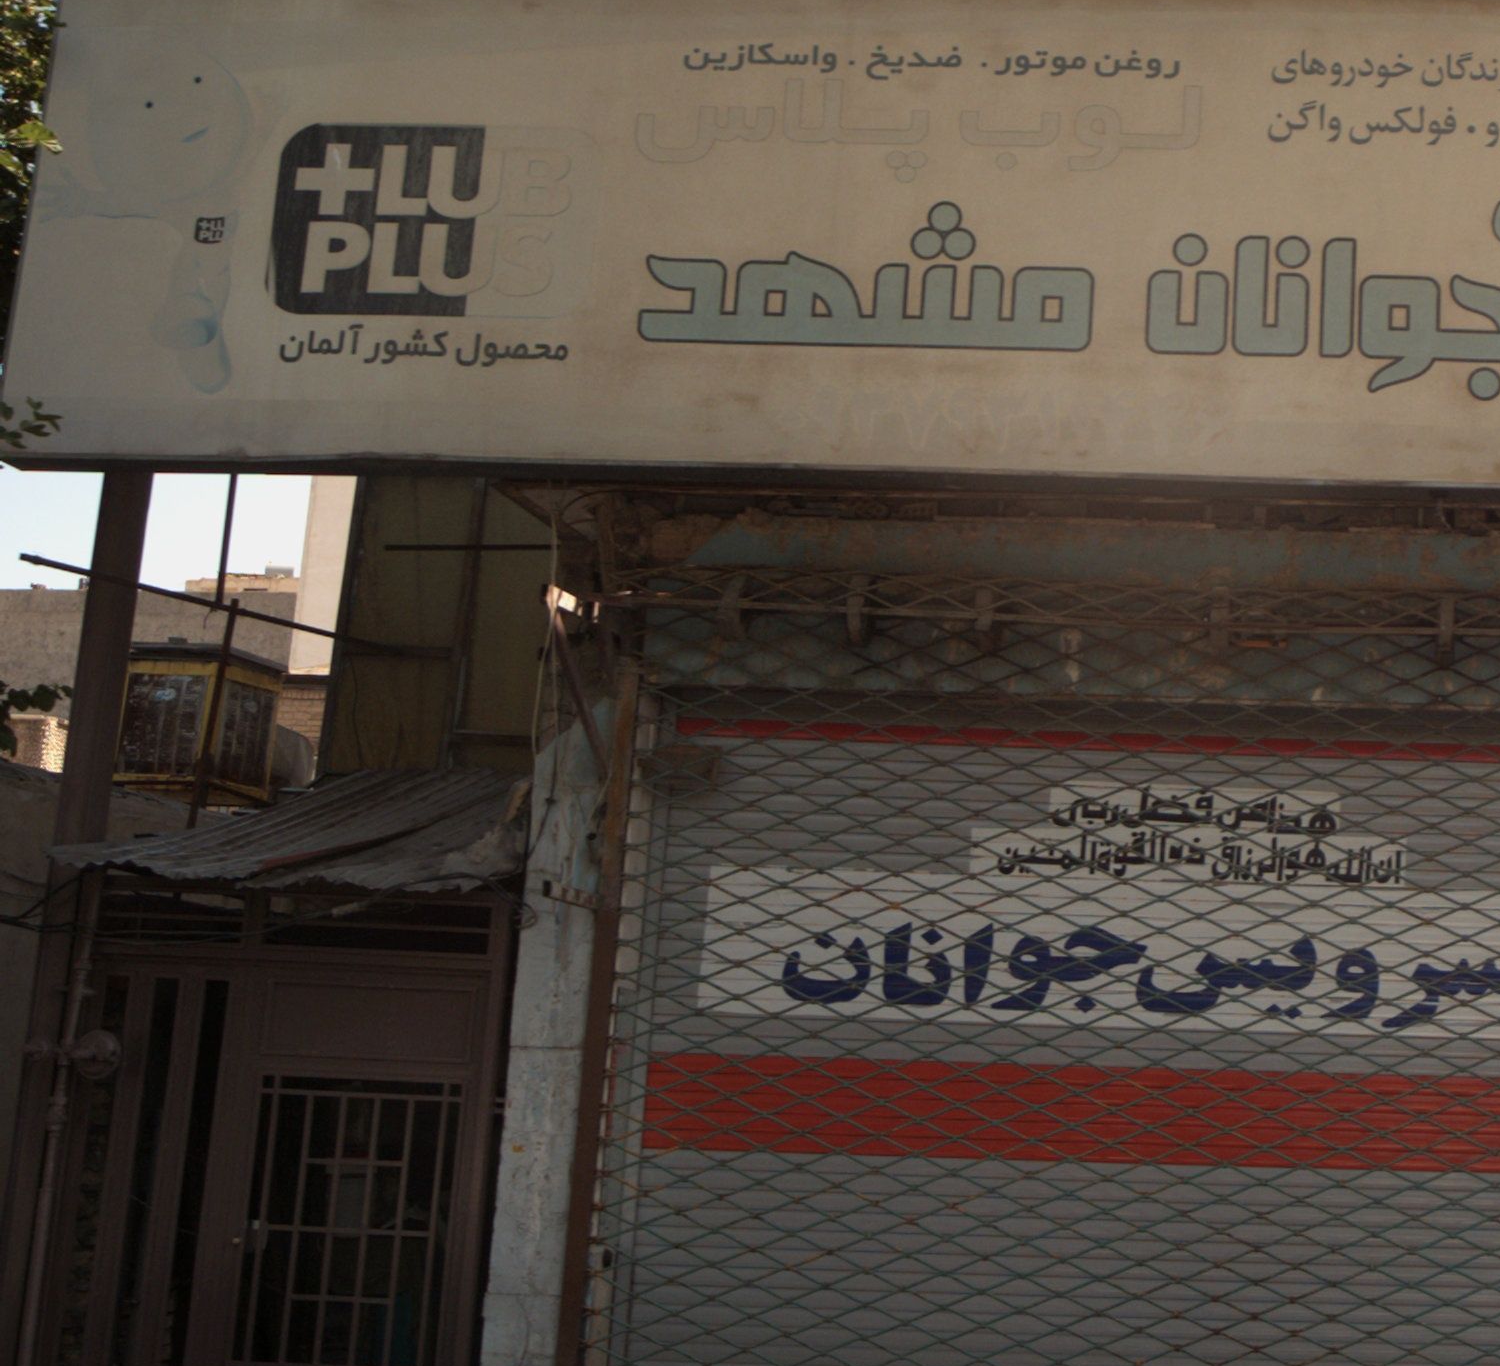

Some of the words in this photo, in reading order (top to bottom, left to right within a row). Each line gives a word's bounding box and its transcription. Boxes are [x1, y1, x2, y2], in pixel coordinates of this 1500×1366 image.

[682, 42, 838, 73] واسکازین
[865, 44, 963, 81] ضدیخ
[995, 49, 1087, 76] موتور
[1094, 47, 1181, 79] روغن
[1270, 48, 1415, 88] خودروهای
[1266, 99, 1342, 143] واگن
[1348, 105, 1459, 146] فولکس
[636, 200, 1096, 351] مشهد
[278, 323, 364, 363] آلمان
[363, 328, 449, 364] کشور
[455, 332, 570, 367] محصول
[781, 921, 1150, 1014] جوانان
